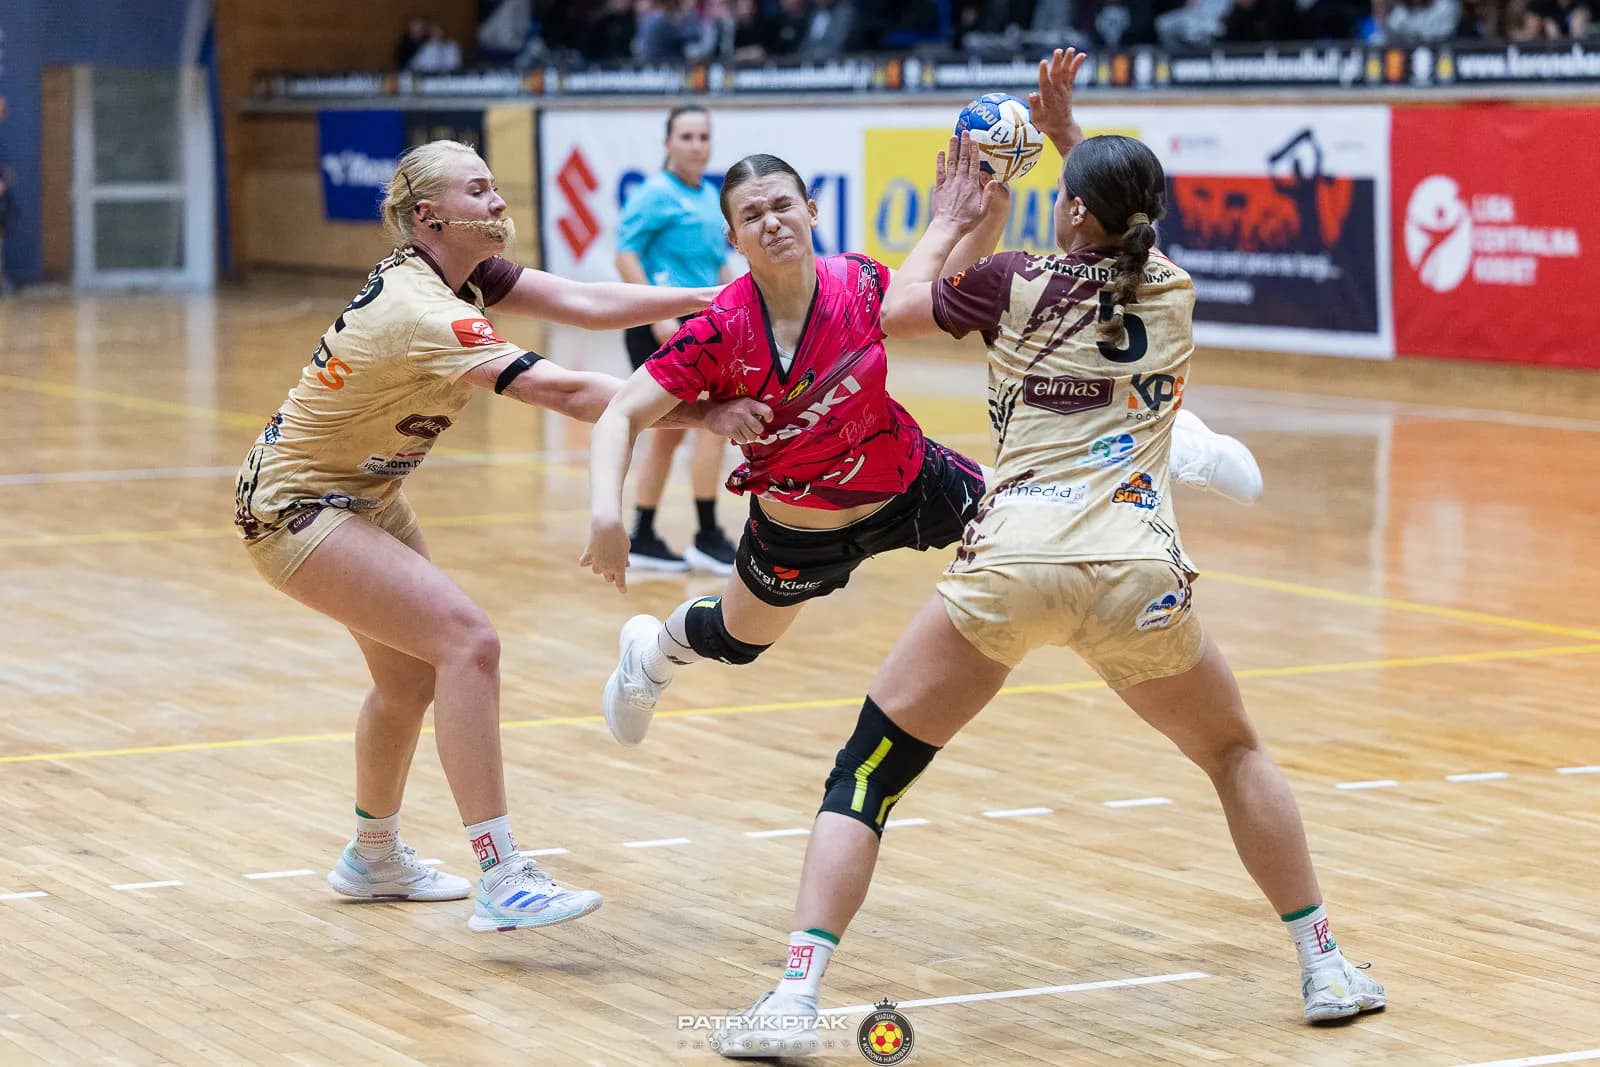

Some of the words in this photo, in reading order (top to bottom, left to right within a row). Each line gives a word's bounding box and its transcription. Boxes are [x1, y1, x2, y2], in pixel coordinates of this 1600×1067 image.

[311, 336, 352, 390] PS
[1034, 377, 1100, 397] elmas
[750, 555, 776, 586] Targi
